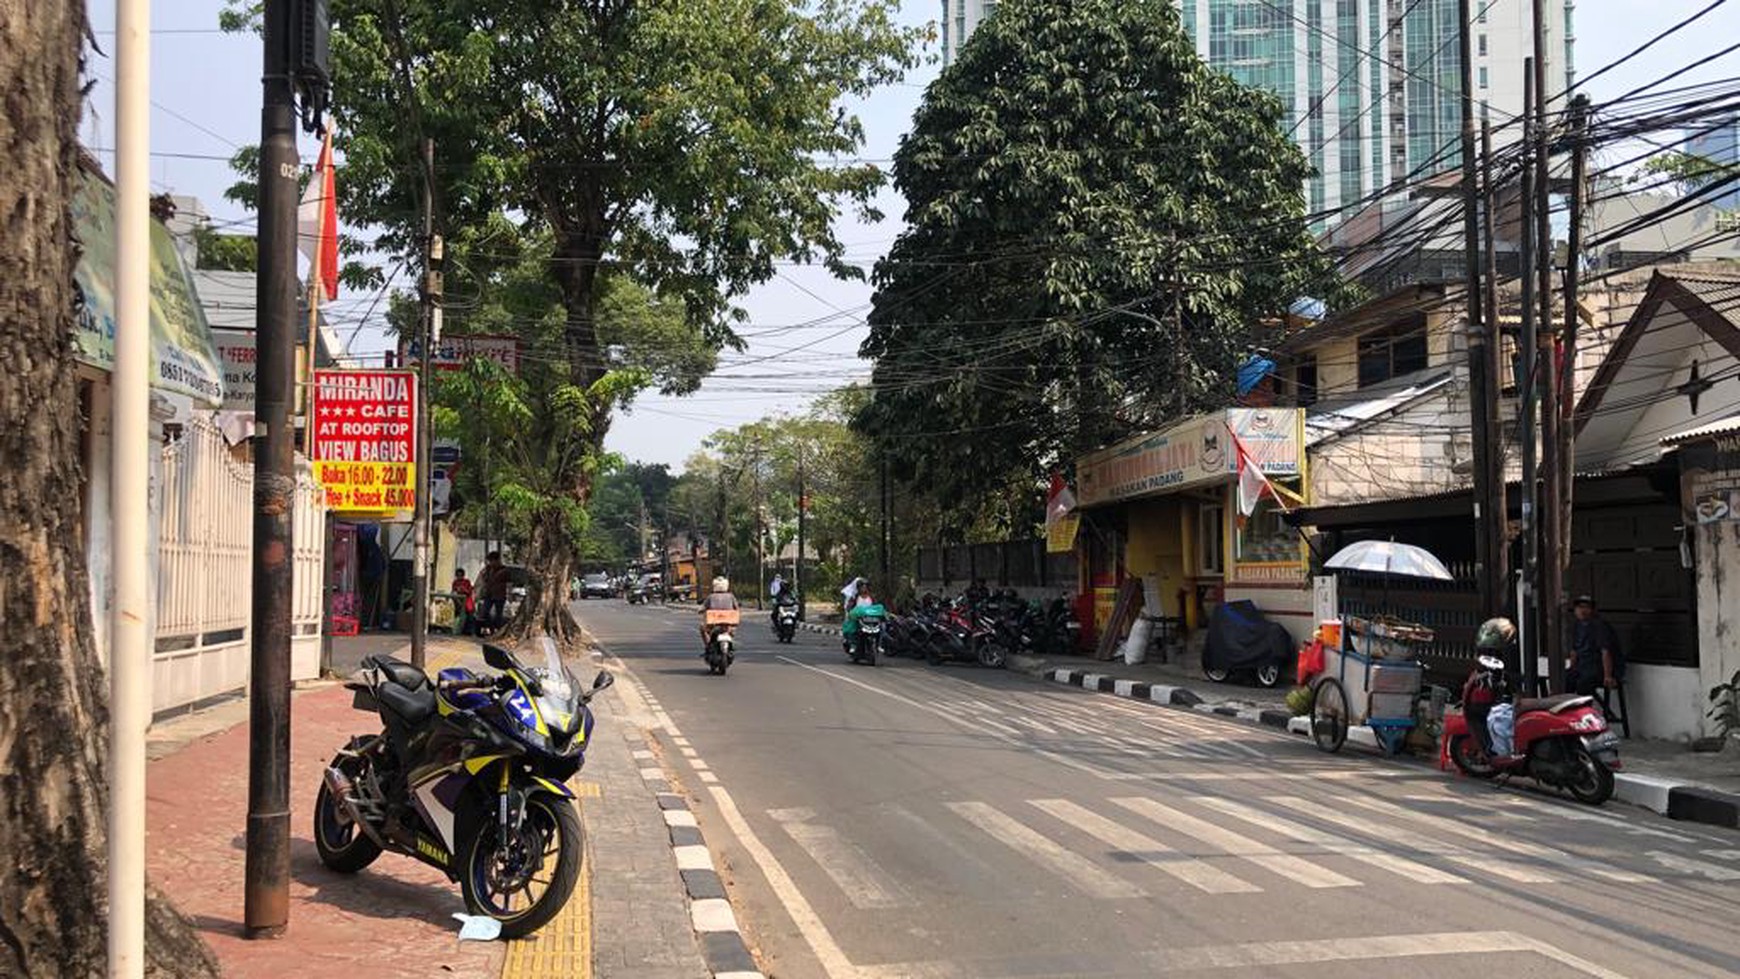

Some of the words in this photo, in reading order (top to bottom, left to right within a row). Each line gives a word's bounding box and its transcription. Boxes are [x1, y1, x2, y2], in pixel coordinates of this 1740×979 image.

[319, 376, 409, 401] MIRANDA
[361, 404, 409, 418] CAFE
[319, 422, 338, 436] AT
[342, 422, 409, 436] ROOFTOP
[318, 440, 357, 462] VIEW
[360, 440, 408, 462] BAGUS
[321, 465, 346, 484] Buka
[348, 466, 375, 486] 16.00
[382, 466, 407, 486] 22.00
[1149, 470, 1185, 488] PADANG
[353, 487, 382, 506] Snack
[384, 488, 415, 508] 45.000
[417, 836, 449, 867] YAMAHA
